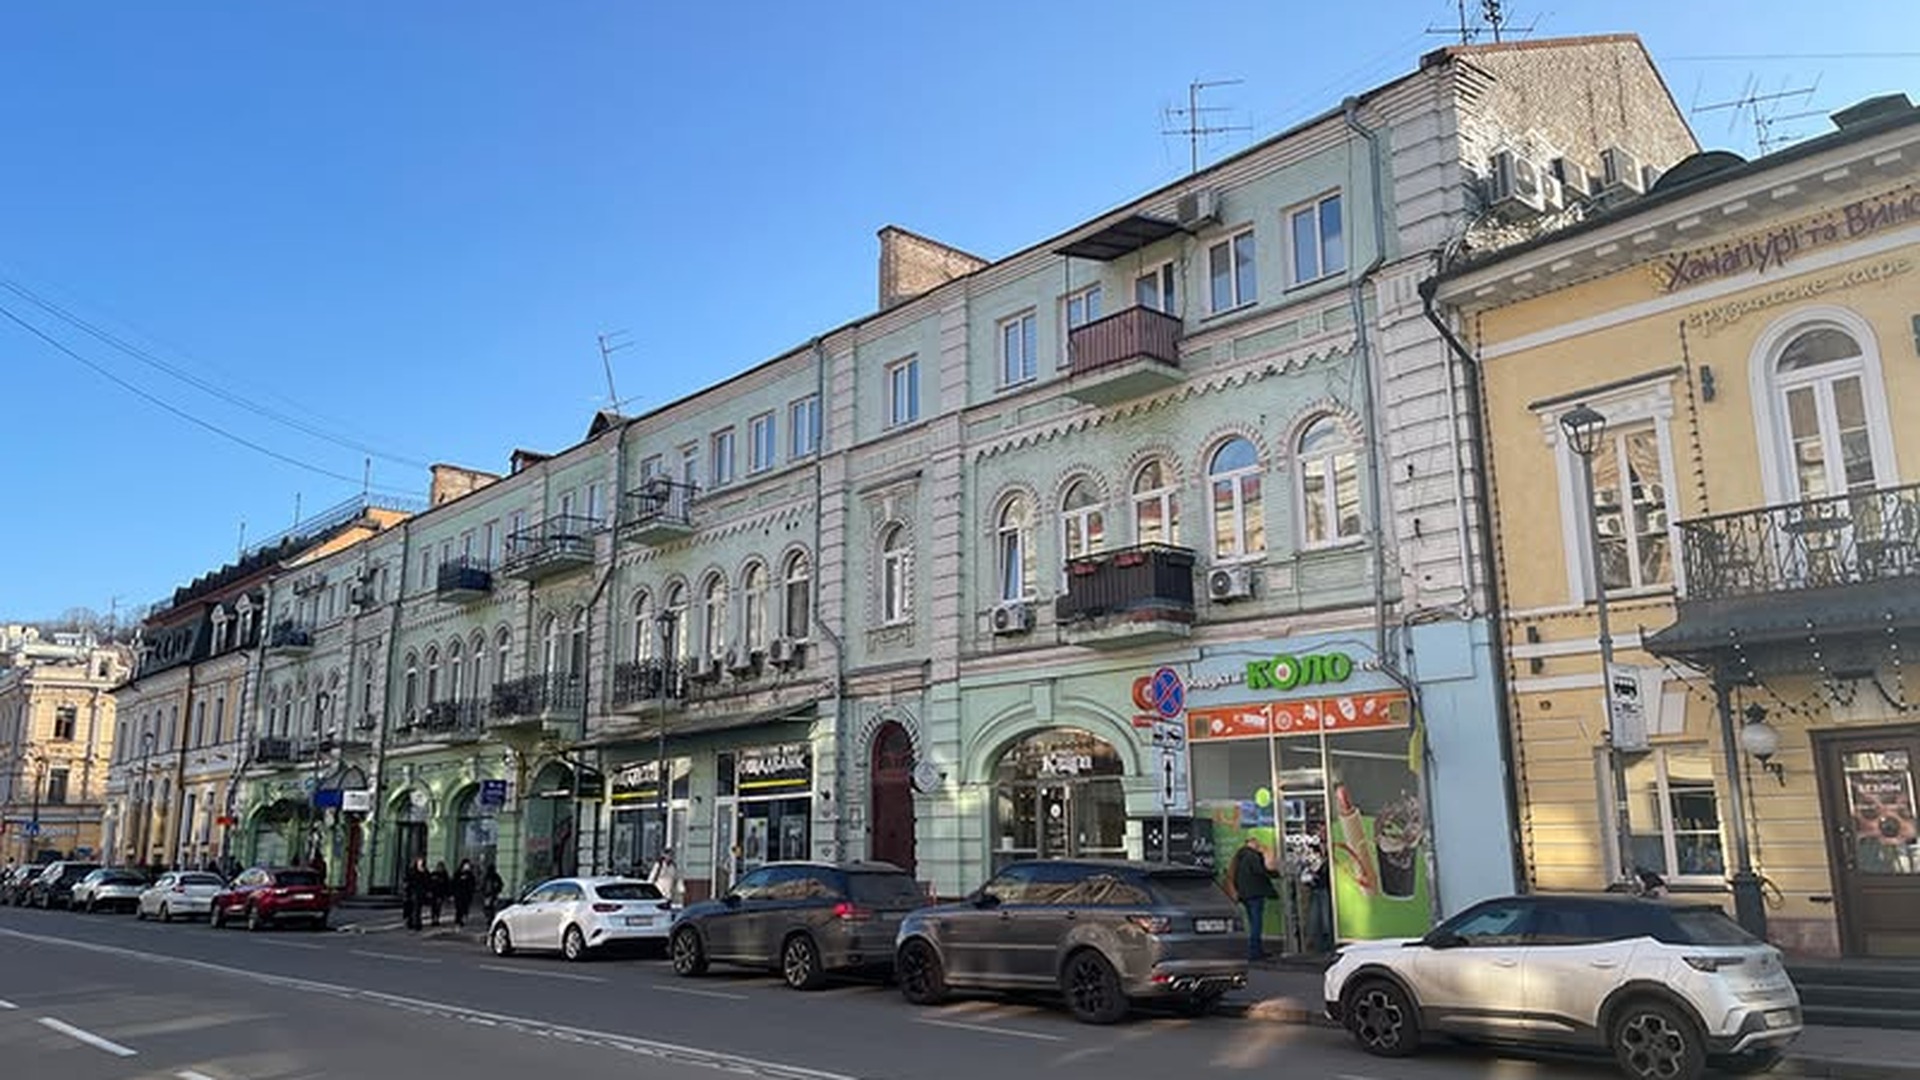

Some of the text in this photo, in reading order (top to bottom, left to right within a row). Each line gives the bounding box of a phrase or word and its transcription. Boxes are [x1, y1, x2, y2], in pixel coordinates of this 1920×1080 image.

[1665, 230, 1800, 291] Хачапурі
[1804, 224, 1837, 243] та
[1839, 258, 1915, 290] кафе
[1246, 652, 1352, 690] КОЛО
